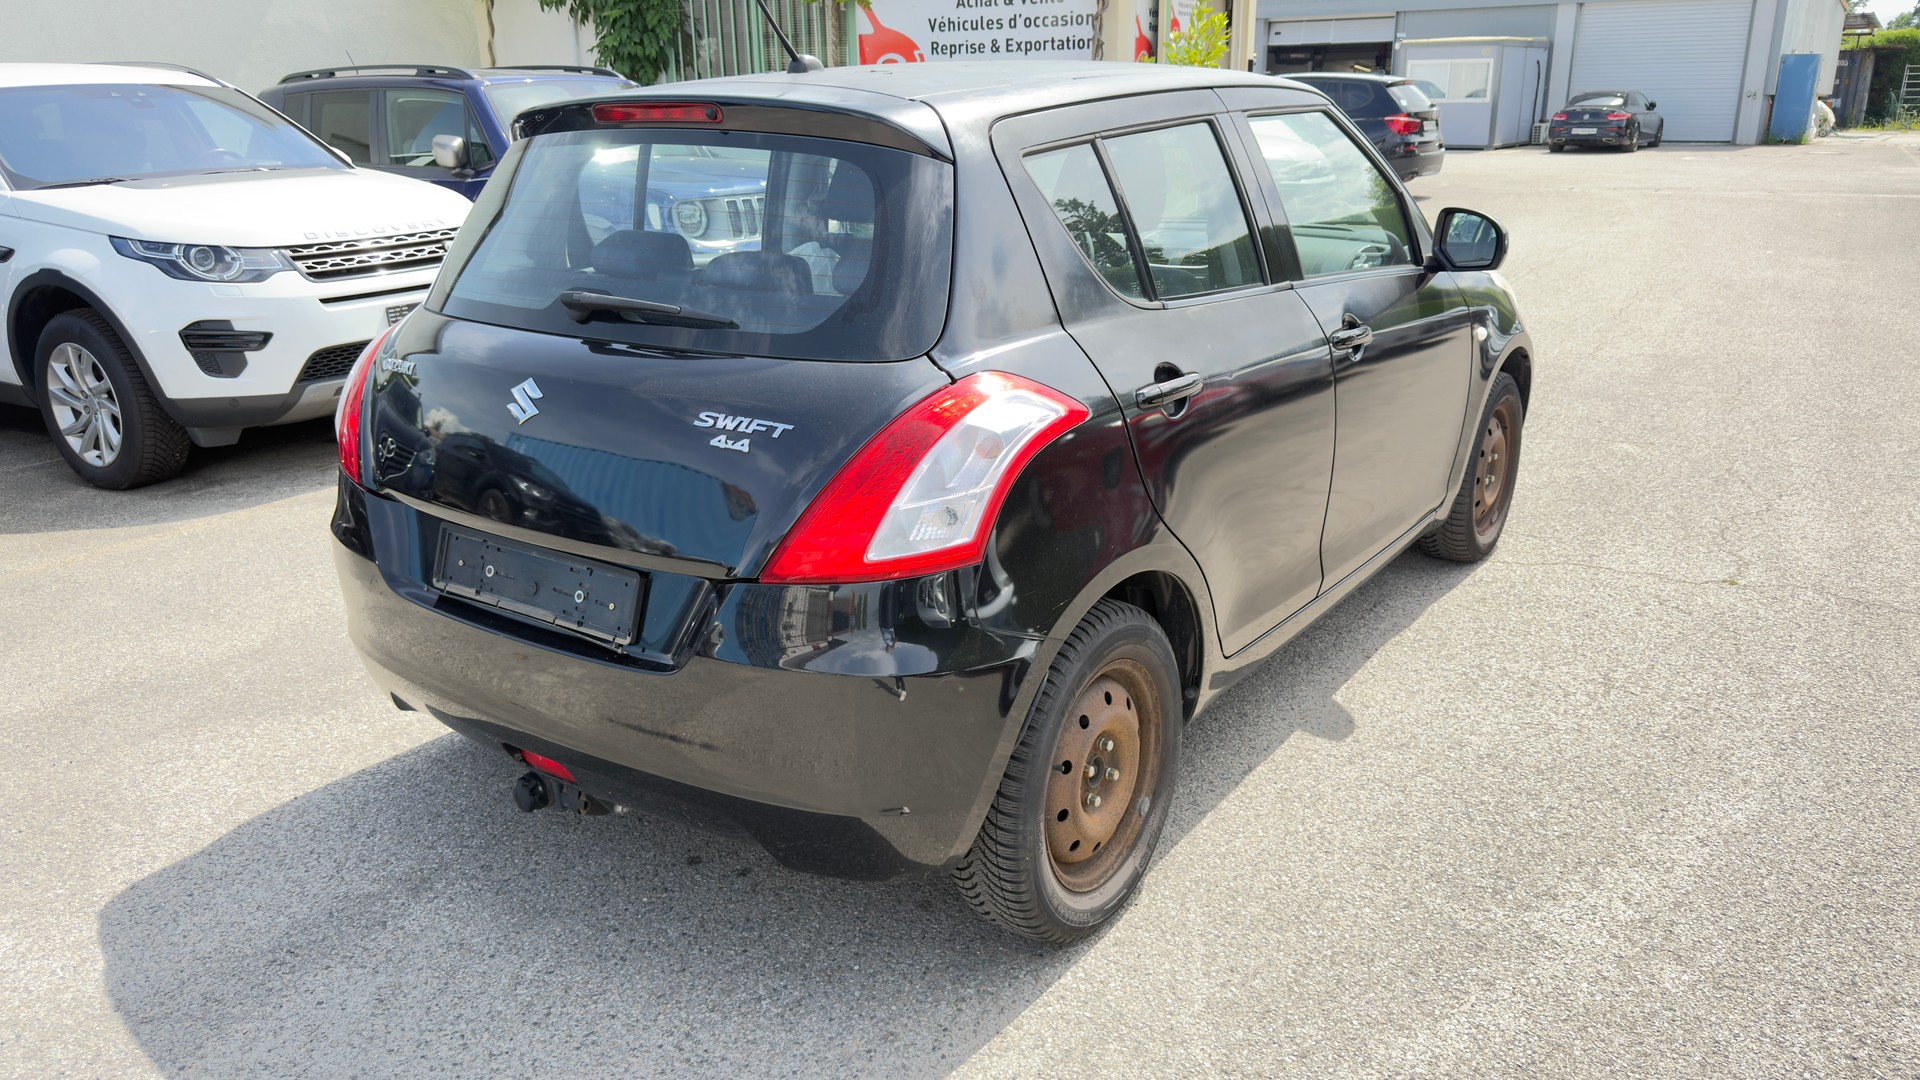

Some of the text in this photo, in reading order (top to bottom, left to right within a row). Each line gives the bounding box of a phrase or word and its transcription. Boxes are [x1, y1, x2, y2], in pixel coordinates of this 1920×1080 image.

[928, 15, 1004, 33] Véhicules
[931, 40, 986, 58] Reprise
[990, 38, 1001, 53] &
[303, 218, 446, 240] DISCOVERY
[693, 411, 795, 438] SWIFT
[709, 434, 751, 453] 4x4
